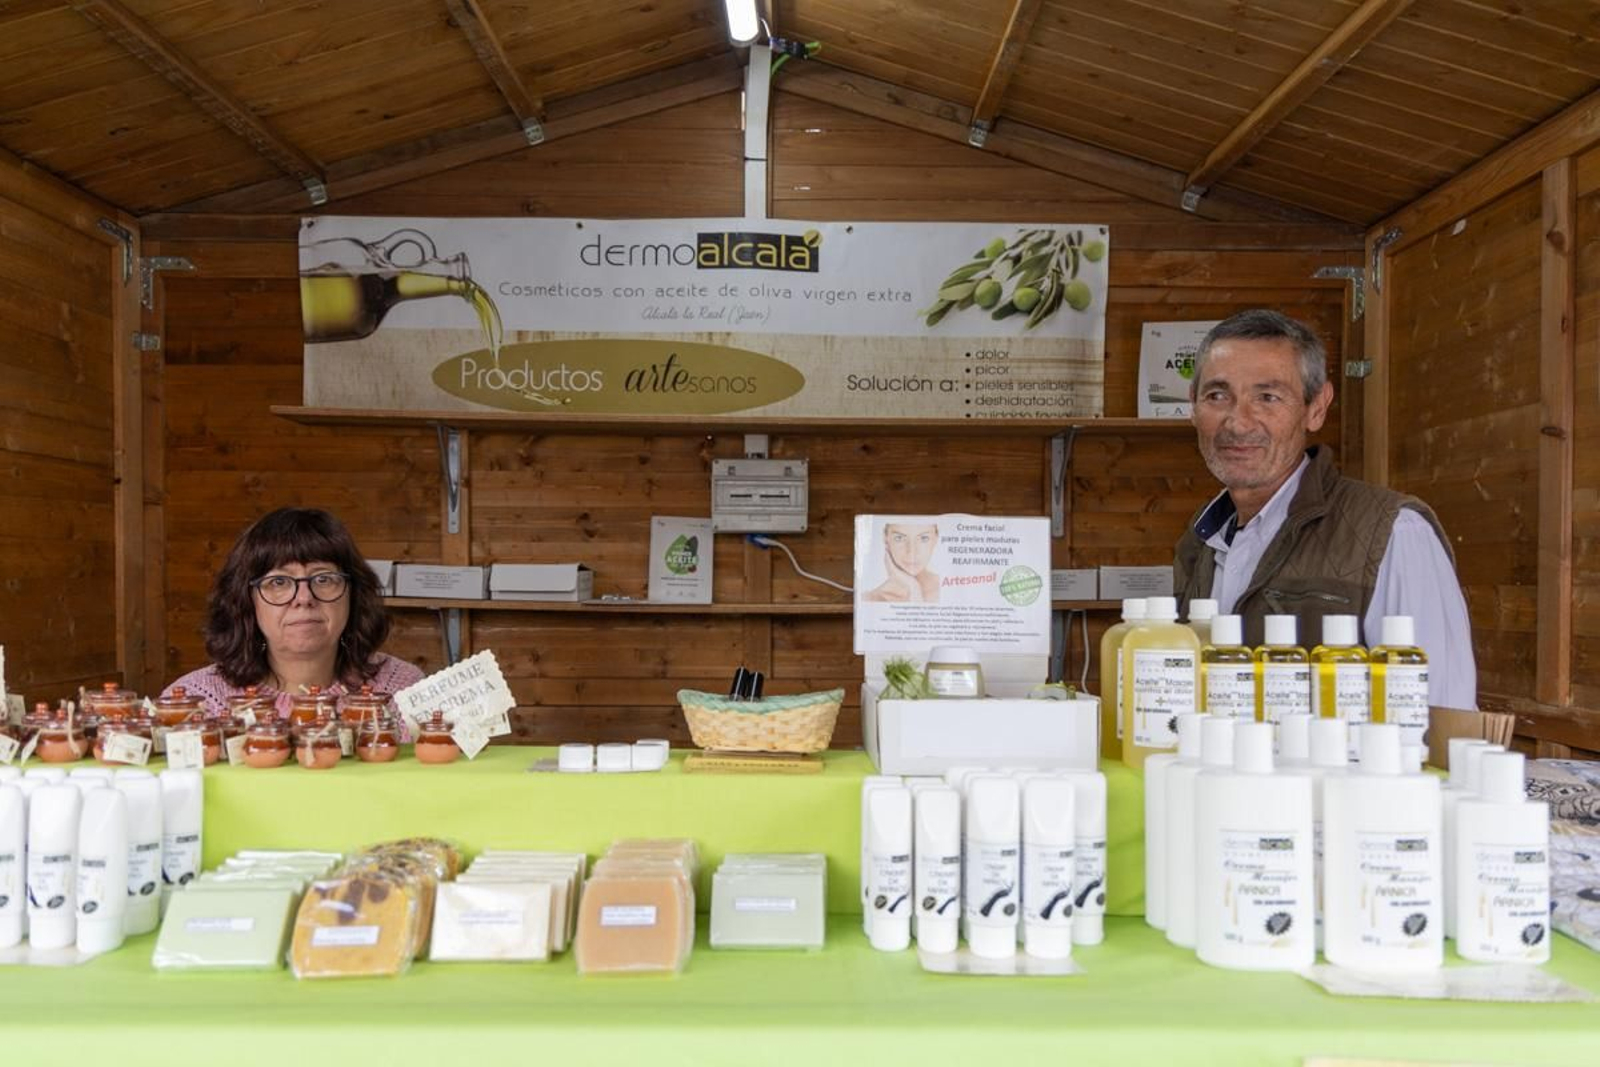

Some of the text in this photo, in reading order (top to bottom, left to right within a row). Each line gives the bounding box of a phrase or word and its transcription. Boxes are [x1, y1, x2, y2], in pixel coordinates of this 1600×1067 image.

[499, 282, 912, 305] Cosméticos con aceite de oliva virgen extra
[683, 306, 695, 320] la
[698, 306, 726, 320] Real
[975, 349, 1010, 360] dolor
[460, 353, 758, 394] Productos artesanos
[975, 364, 1010, 376] picor
[848, 373, 959, 392] Solución a:
[975, 380, 1075, 392] pieles sensibles
[975, 395, 1074, 407] deshidratación
[956, 523, 1005, 532] Crema facial
[941, 536, 1021, 544] para pieles maduras
[948, 546, 1014, 555] REGENERADORA
[952, 557, 1010, 566] REAFIRMANTE
[941, 571, 997, 587] Artesanal
[408, 660, 485, 708] PERFUME
[438, 679, 496, 713] CREMA
